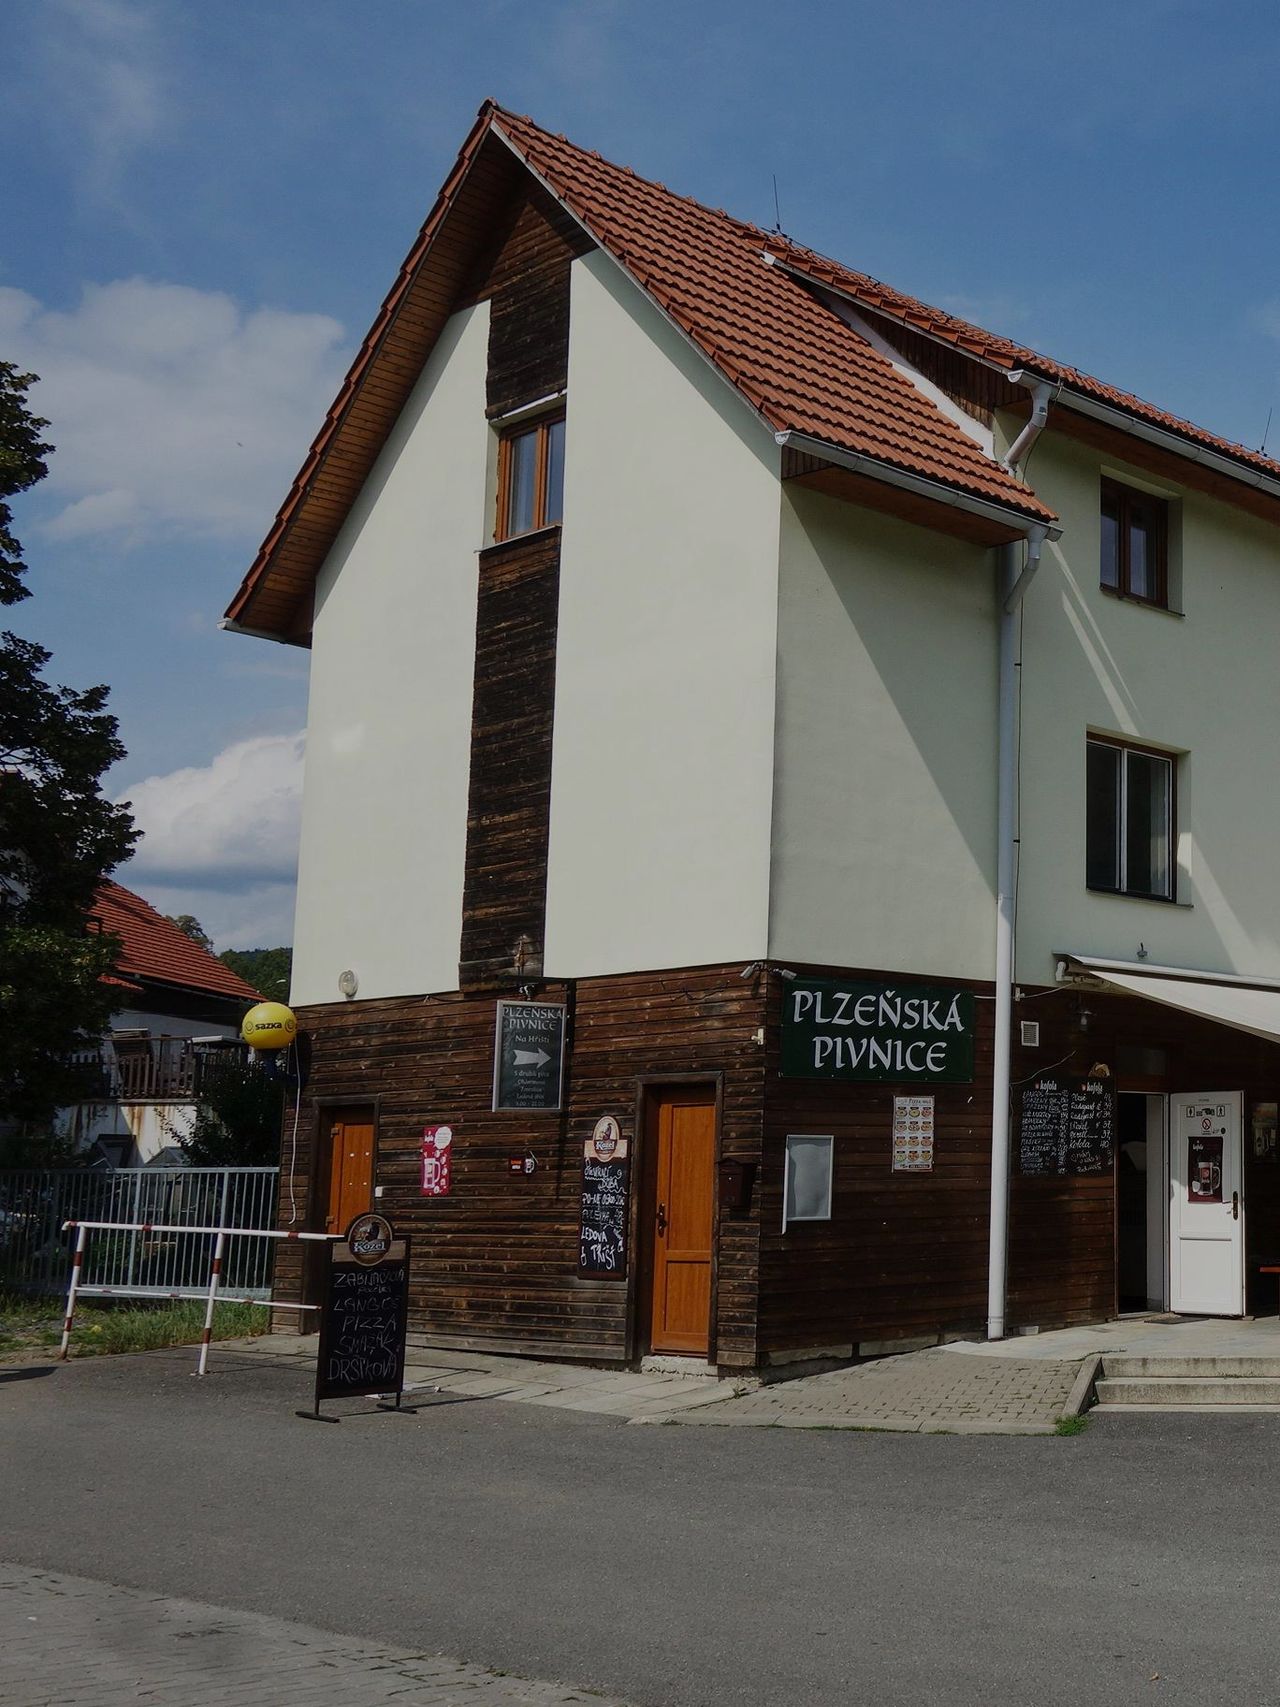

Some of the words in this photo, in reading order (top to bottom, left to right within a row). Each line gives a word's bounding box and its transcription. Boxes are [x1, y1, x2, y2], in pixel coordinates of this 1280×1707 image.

[792, 990, 965, 1032] PLZEŇSKÁ
[510, 1018, 557, 1030] PIVNICE
[812, 1036, 947, 1072] PIVNICE
[353, 1241, 385, 1253] Kozel
[342, 1313, 397, 1332] PIZZA
